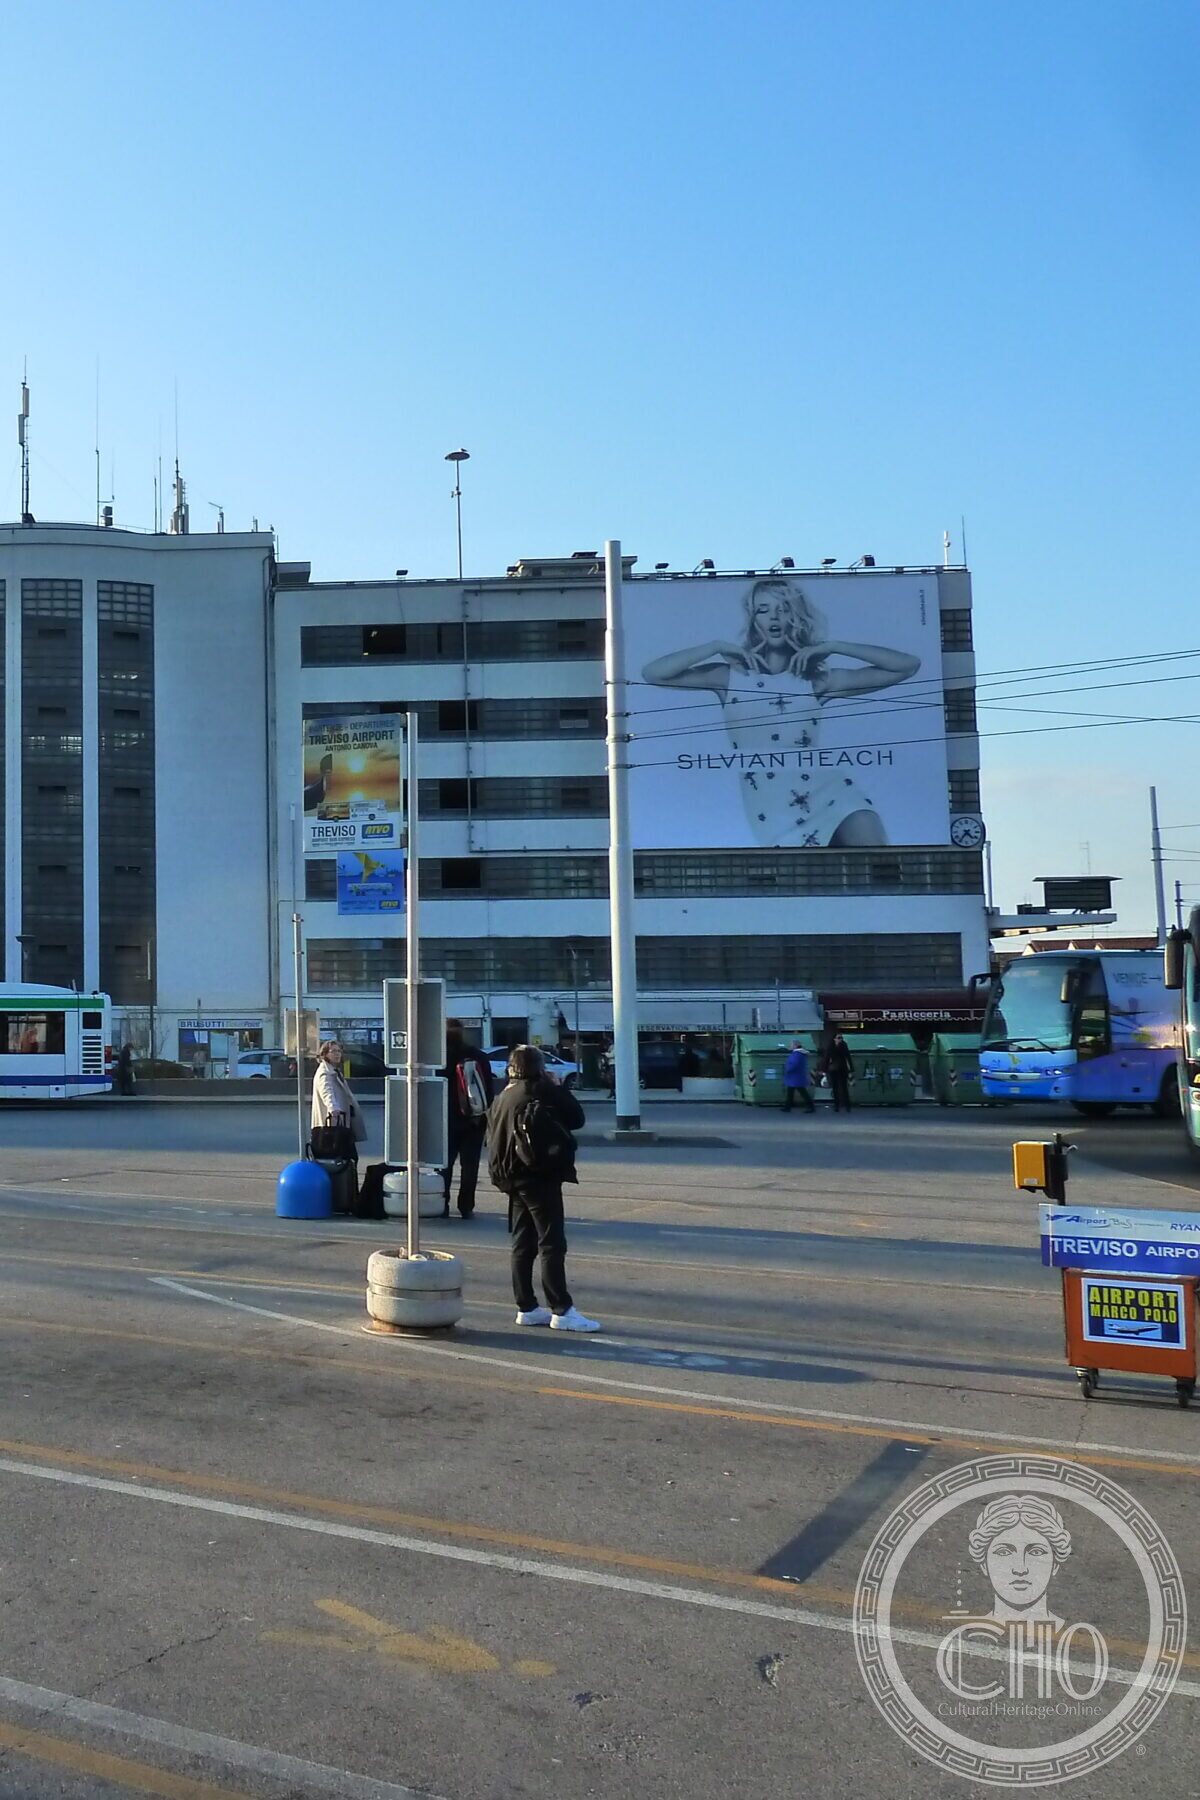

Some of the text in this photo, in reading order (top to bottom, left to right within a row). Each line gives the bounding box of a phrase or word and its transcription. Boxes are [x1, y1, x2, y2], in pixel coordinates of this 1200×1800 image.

[350, 719, 395, 730] DEPARTURES
[309, 730, 395, 745] TREVISO AIRPORT
[353, 742, 378, 750] CANOVA
[677, 750, 893, 770] SILVIAN HEACH
[311, 825, 356, 837] TREVISO
[1113, 972, 1148, 984] VENICE
[882, 1010, 951, 1019] Pasticceria
[1066, 1215, 1107, 1226] Airport
[1051, 1237, 1200, 1259] TREVISO AIRPO
[1089, 1286, 1178, 1309] AIRPORT
[1090, 1304, 1177, 1323] MARCO POLO
